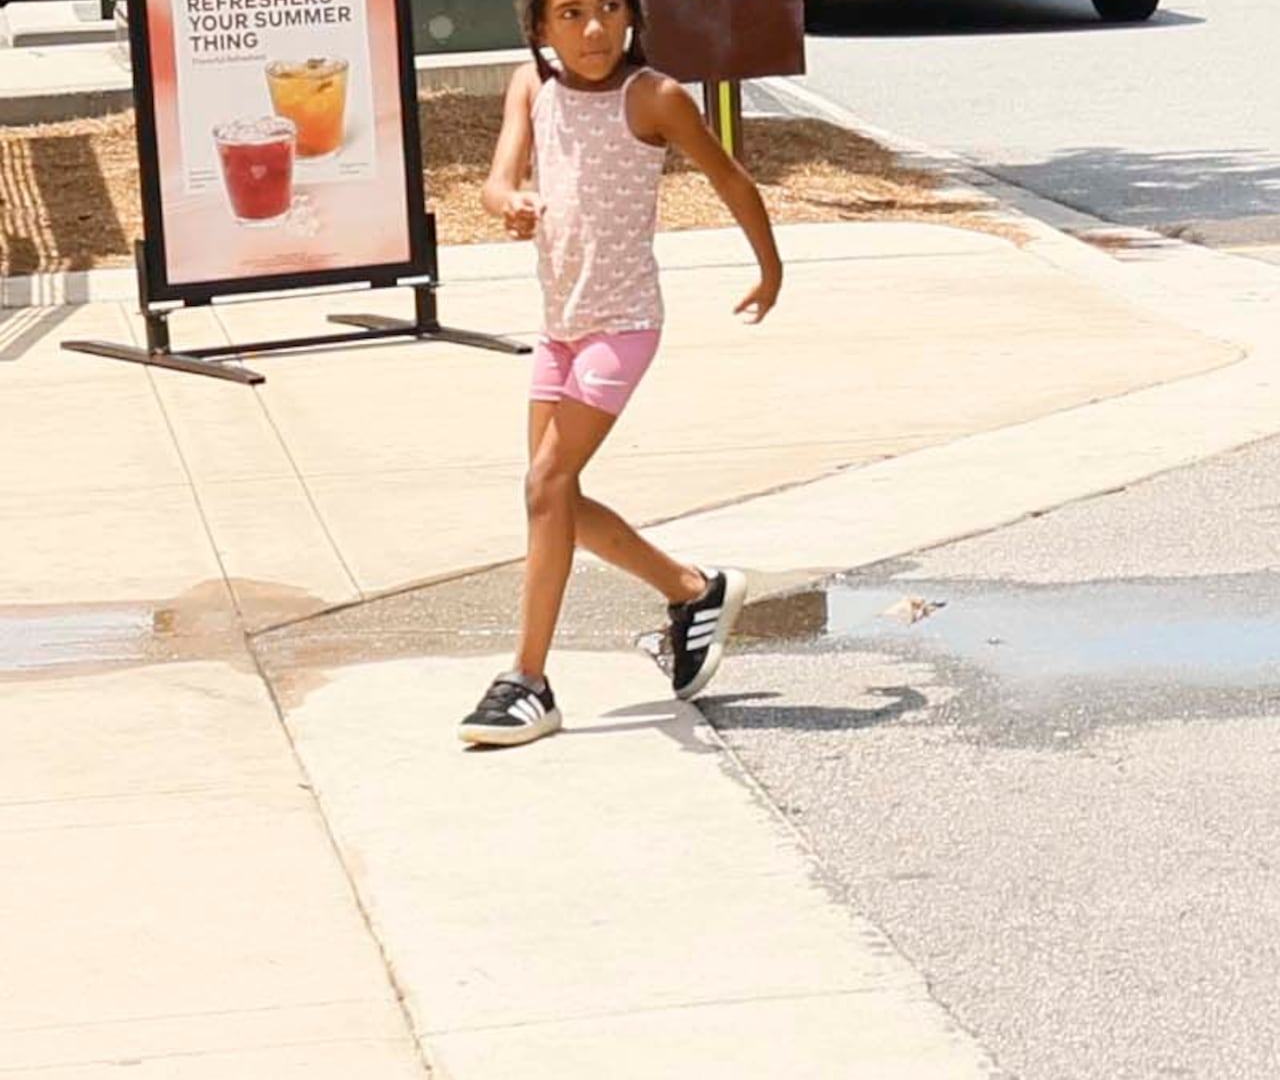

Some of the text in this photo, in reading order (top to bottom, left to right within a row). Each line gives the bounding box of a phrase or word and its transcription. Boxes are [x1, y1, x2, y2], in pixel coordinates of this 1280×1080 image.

[189, 6, 352, 32] YOUR SUMMER
[189, 32, 258, 52] THING
